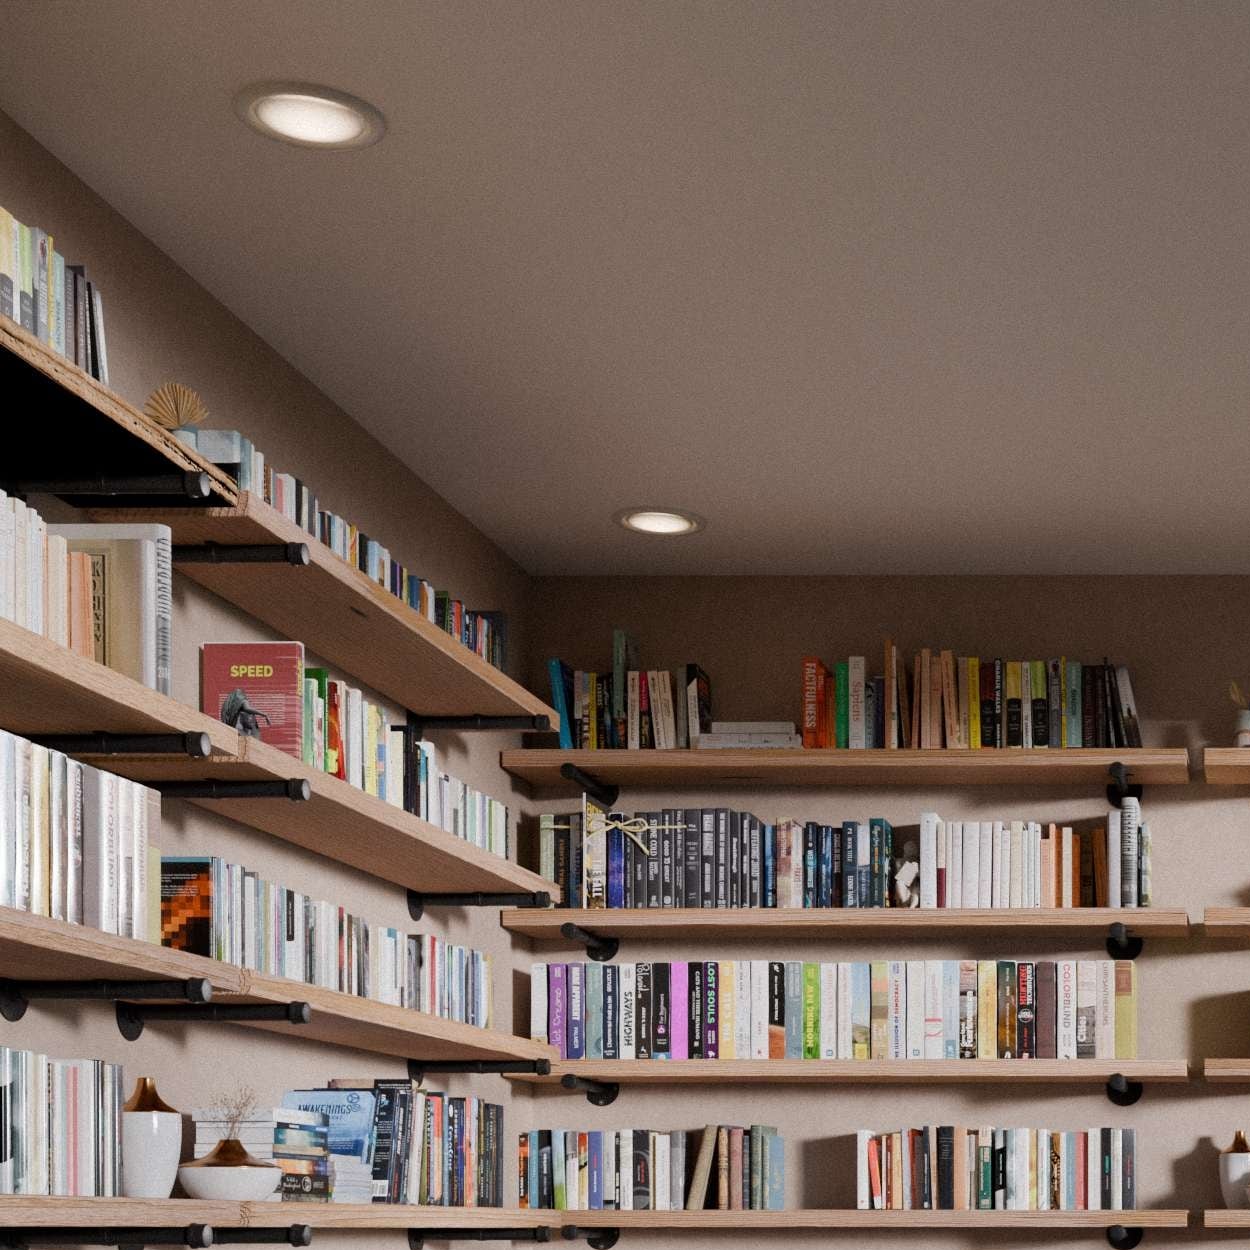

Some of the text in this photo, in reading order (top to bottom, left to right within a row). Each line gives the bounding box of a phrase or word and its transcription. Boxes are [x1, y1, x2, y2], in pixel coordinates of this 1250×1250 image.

[230, 665, 273, 677] SPEED
[805, 662, 817, 728] FACTFULNESS
[850, 680, 861, 722] Sapiens
[649, 840, 658, 857] COLD
[591, 859, 604, 898] THE FALL
[707, 962, 716, 988] LOST
[707, 990, 716, 1024] SOULS
[1063, 963, 1072, 1028] COLORBLIND
[624, 991, 633, 1046] HIGHWAYS
[806, 1007, 815, 1048] MORNING
